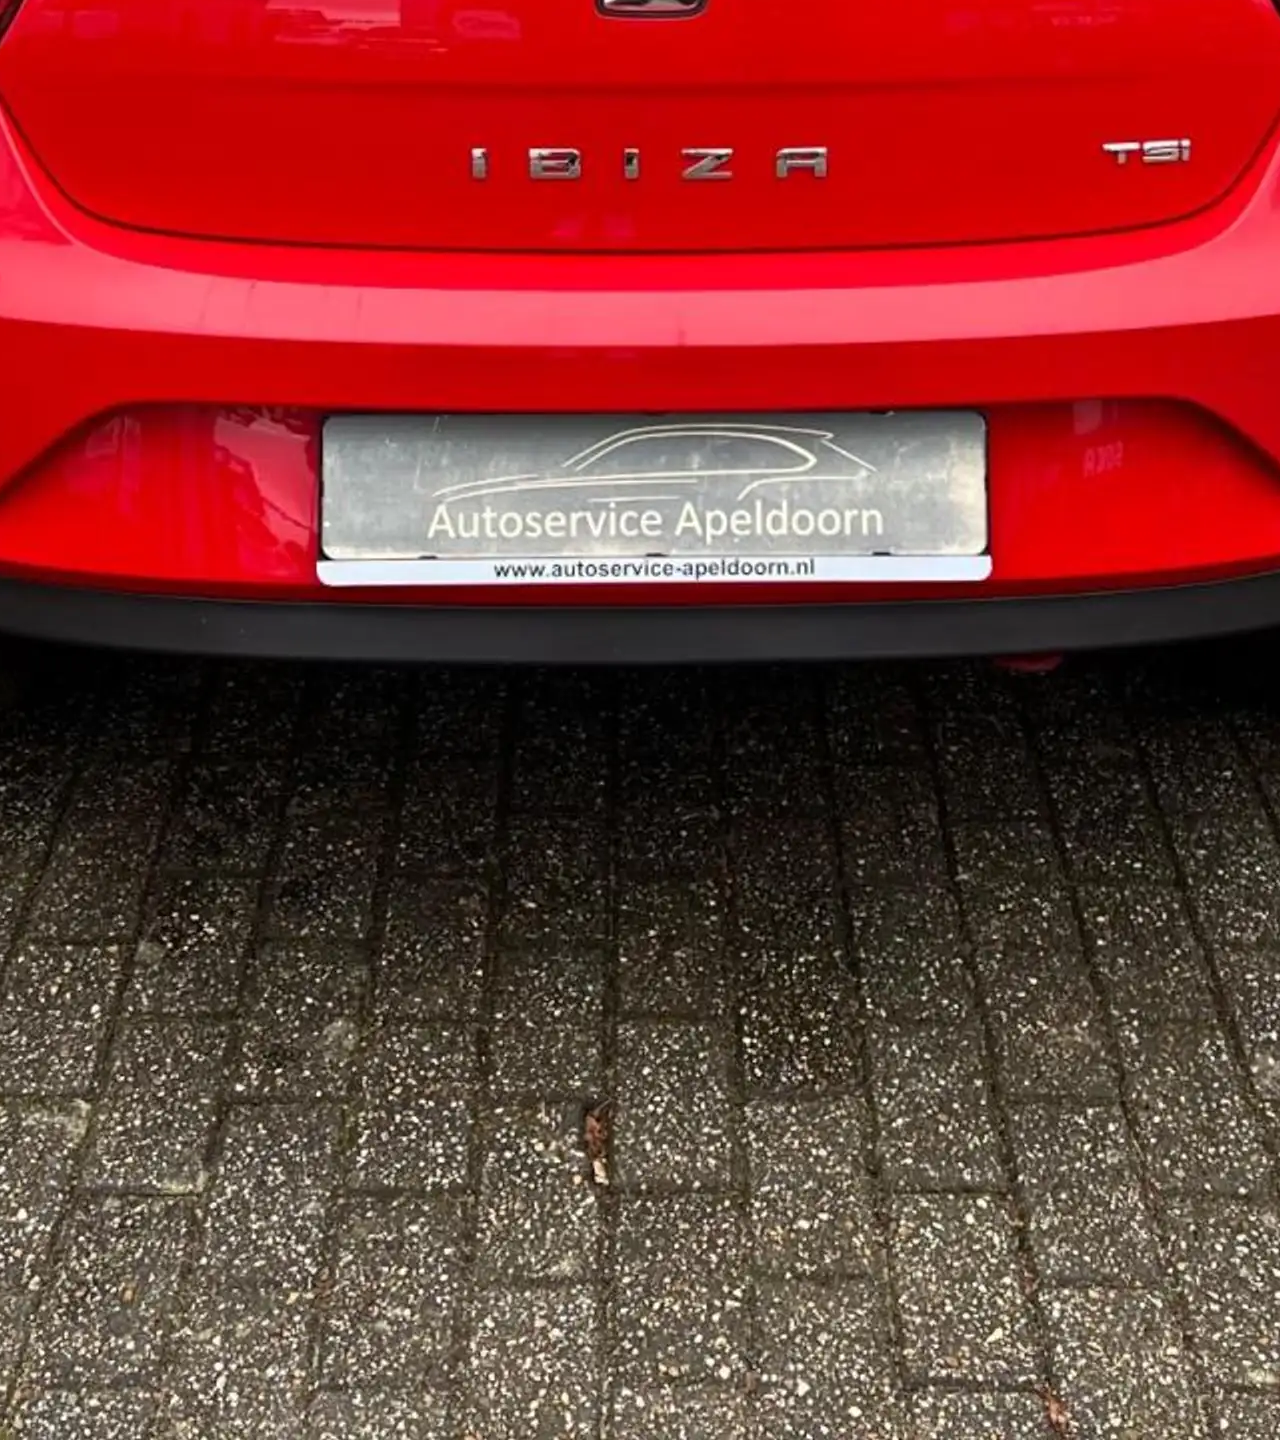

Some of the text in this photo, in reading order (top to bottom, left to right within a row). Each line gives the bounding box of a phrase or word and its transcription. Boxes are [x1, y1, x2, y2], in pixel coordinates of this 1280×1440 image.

[470, 147, 827, 180] IBIZA
[427, 499, 884, 544] Autoservice Apeldoorn
[493, 558, 816, 581] www.autoservice-apeldoorn.nl
